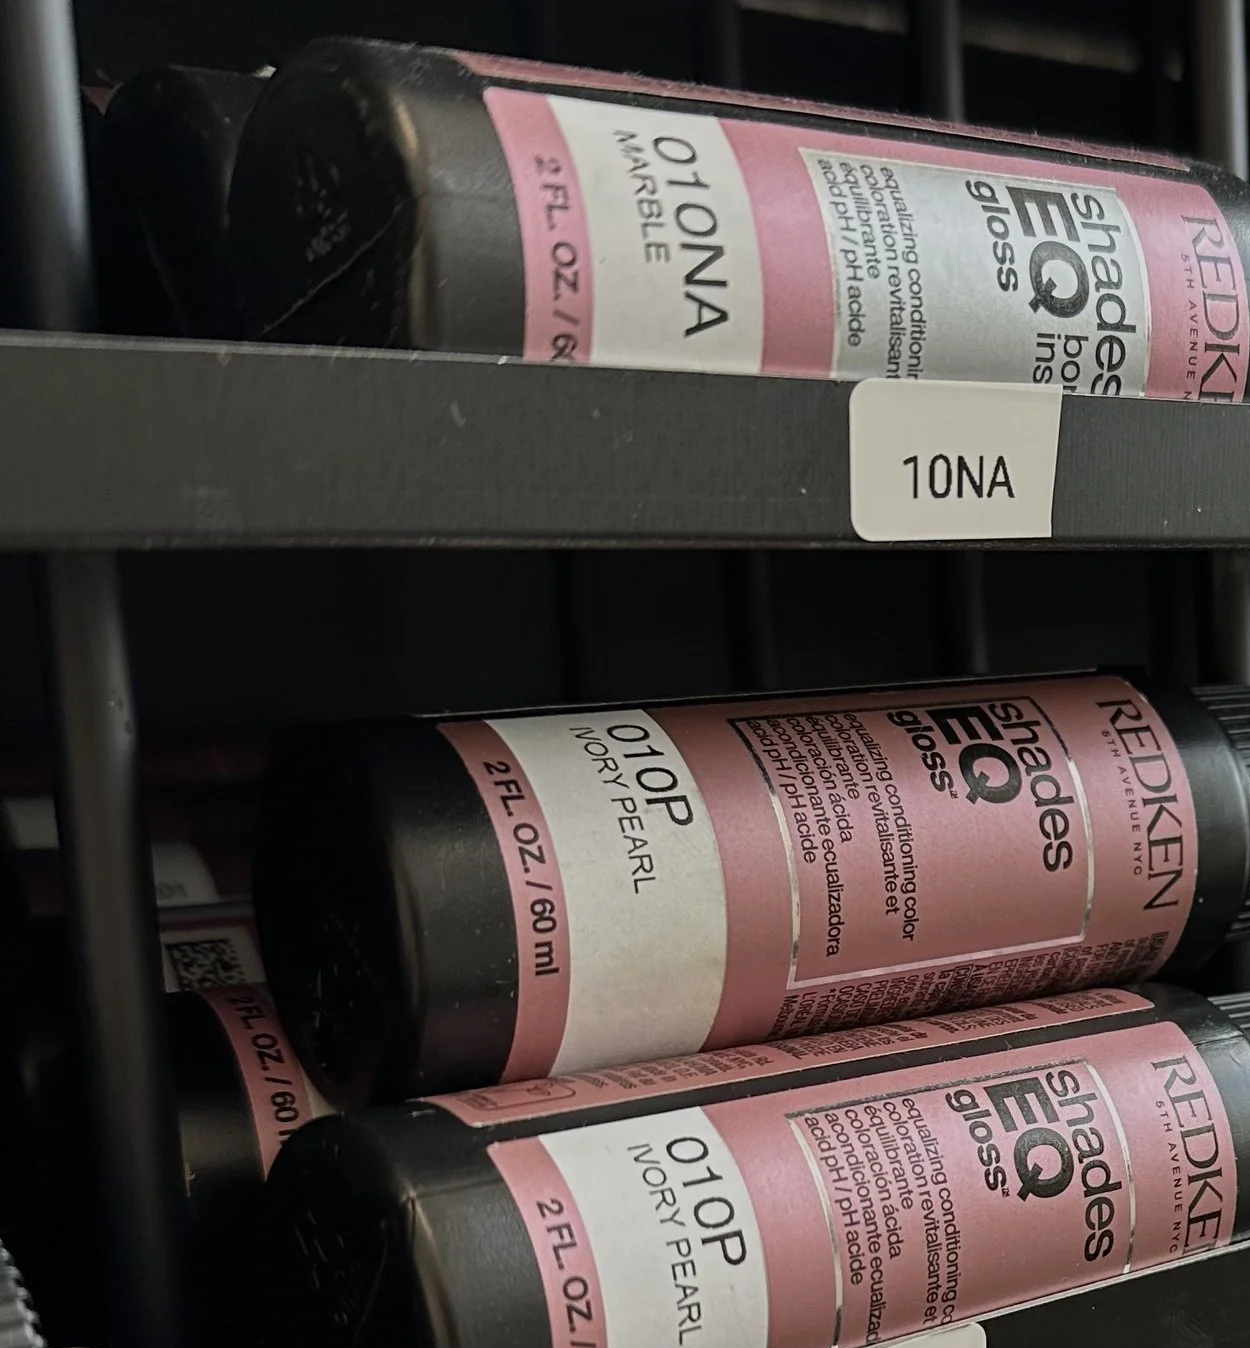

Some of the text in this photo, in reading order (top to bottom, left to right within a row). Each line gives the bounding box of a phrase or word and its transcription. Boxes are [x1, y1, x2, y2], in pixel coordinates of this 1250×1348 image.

[613, 129, 671, 263] MARBLE
[818, 159, 842, 198] acid
[830, 200, 854, 233] pH
[860, 164, 899, 265] coloration
[880, 165, 919, 264] equalizing
[654, 136, 729, 338] 010NA
[841, 248, 864, 281] pH
[965, 179, 1019, 293] gloss
[1004, 185, 1090, 319] EQ
[847, 284, 867, 348] acide
[1180, 253, 1200, 381] 5TH AVENUE
[902, 453, 1016, 499] 10NA
[605, 724, 695, 827] 010P
[746, 719, 774, 750] acid
[765, 749, 790, 771] pH
[786, 716, 854, 844] coloración ácida
[806, 715, 860, 801] équilibrante
[925, 706, 1023, 806] EQ
[988, 702, 1074, 873] shades
[568, 726, 657, 895] IVORY PEARL
[766, 718, 846, 958] acondicionante ecualizadora
[783, 783, 803, 809] pH
[791, 812, 817, 864] acide
[824, 713, 900, 916] coloration revitalisante et
[843, 712, 920, 942] equalizing conditioning color
[1097, 699, 1185, 912] REDKEN
[1101, 729, 1143, 876] 5TH AVENUE NYC
[483, 760, 561, 978] 2 FL. OZ. / 60 ml
[250, 1032, 285, 1072] OZ.
[268, 1088, 300, 1124] 60
[804, 1116, 834, 1154] acid
[820, 1154, 849, 1184] pH
[824, 1112, 882, 1254] acondicionante
[844, 1108, 903, 1260] coloración ácida
[863, 1104, 915, 1211] équilibrante
[983, 1075, 1076, 1202] EQ
[1044, 1068, 1123, 1263] shades
[1150, 1054, 1225, 1257] REDKE
[1154, 1099, 1183, 1255] 5TH AVENUE NYC
[535, 1198, 564, 1219] 2
[546, 1222, 578, 1271] FL.
[626, 1143, 703, 1347] IVORY PEARL
[665, 1135, 748, 1267] 010P
[834, 1197, 862, 1228] pH
[845, 1229, 868, 1286] acide
[883, 1100, 943, 1325] coloration revitalisante et
[902, 1097, 962, 1308] equalizing conditioning
[562, 1275, 594, 1332] OZ.
